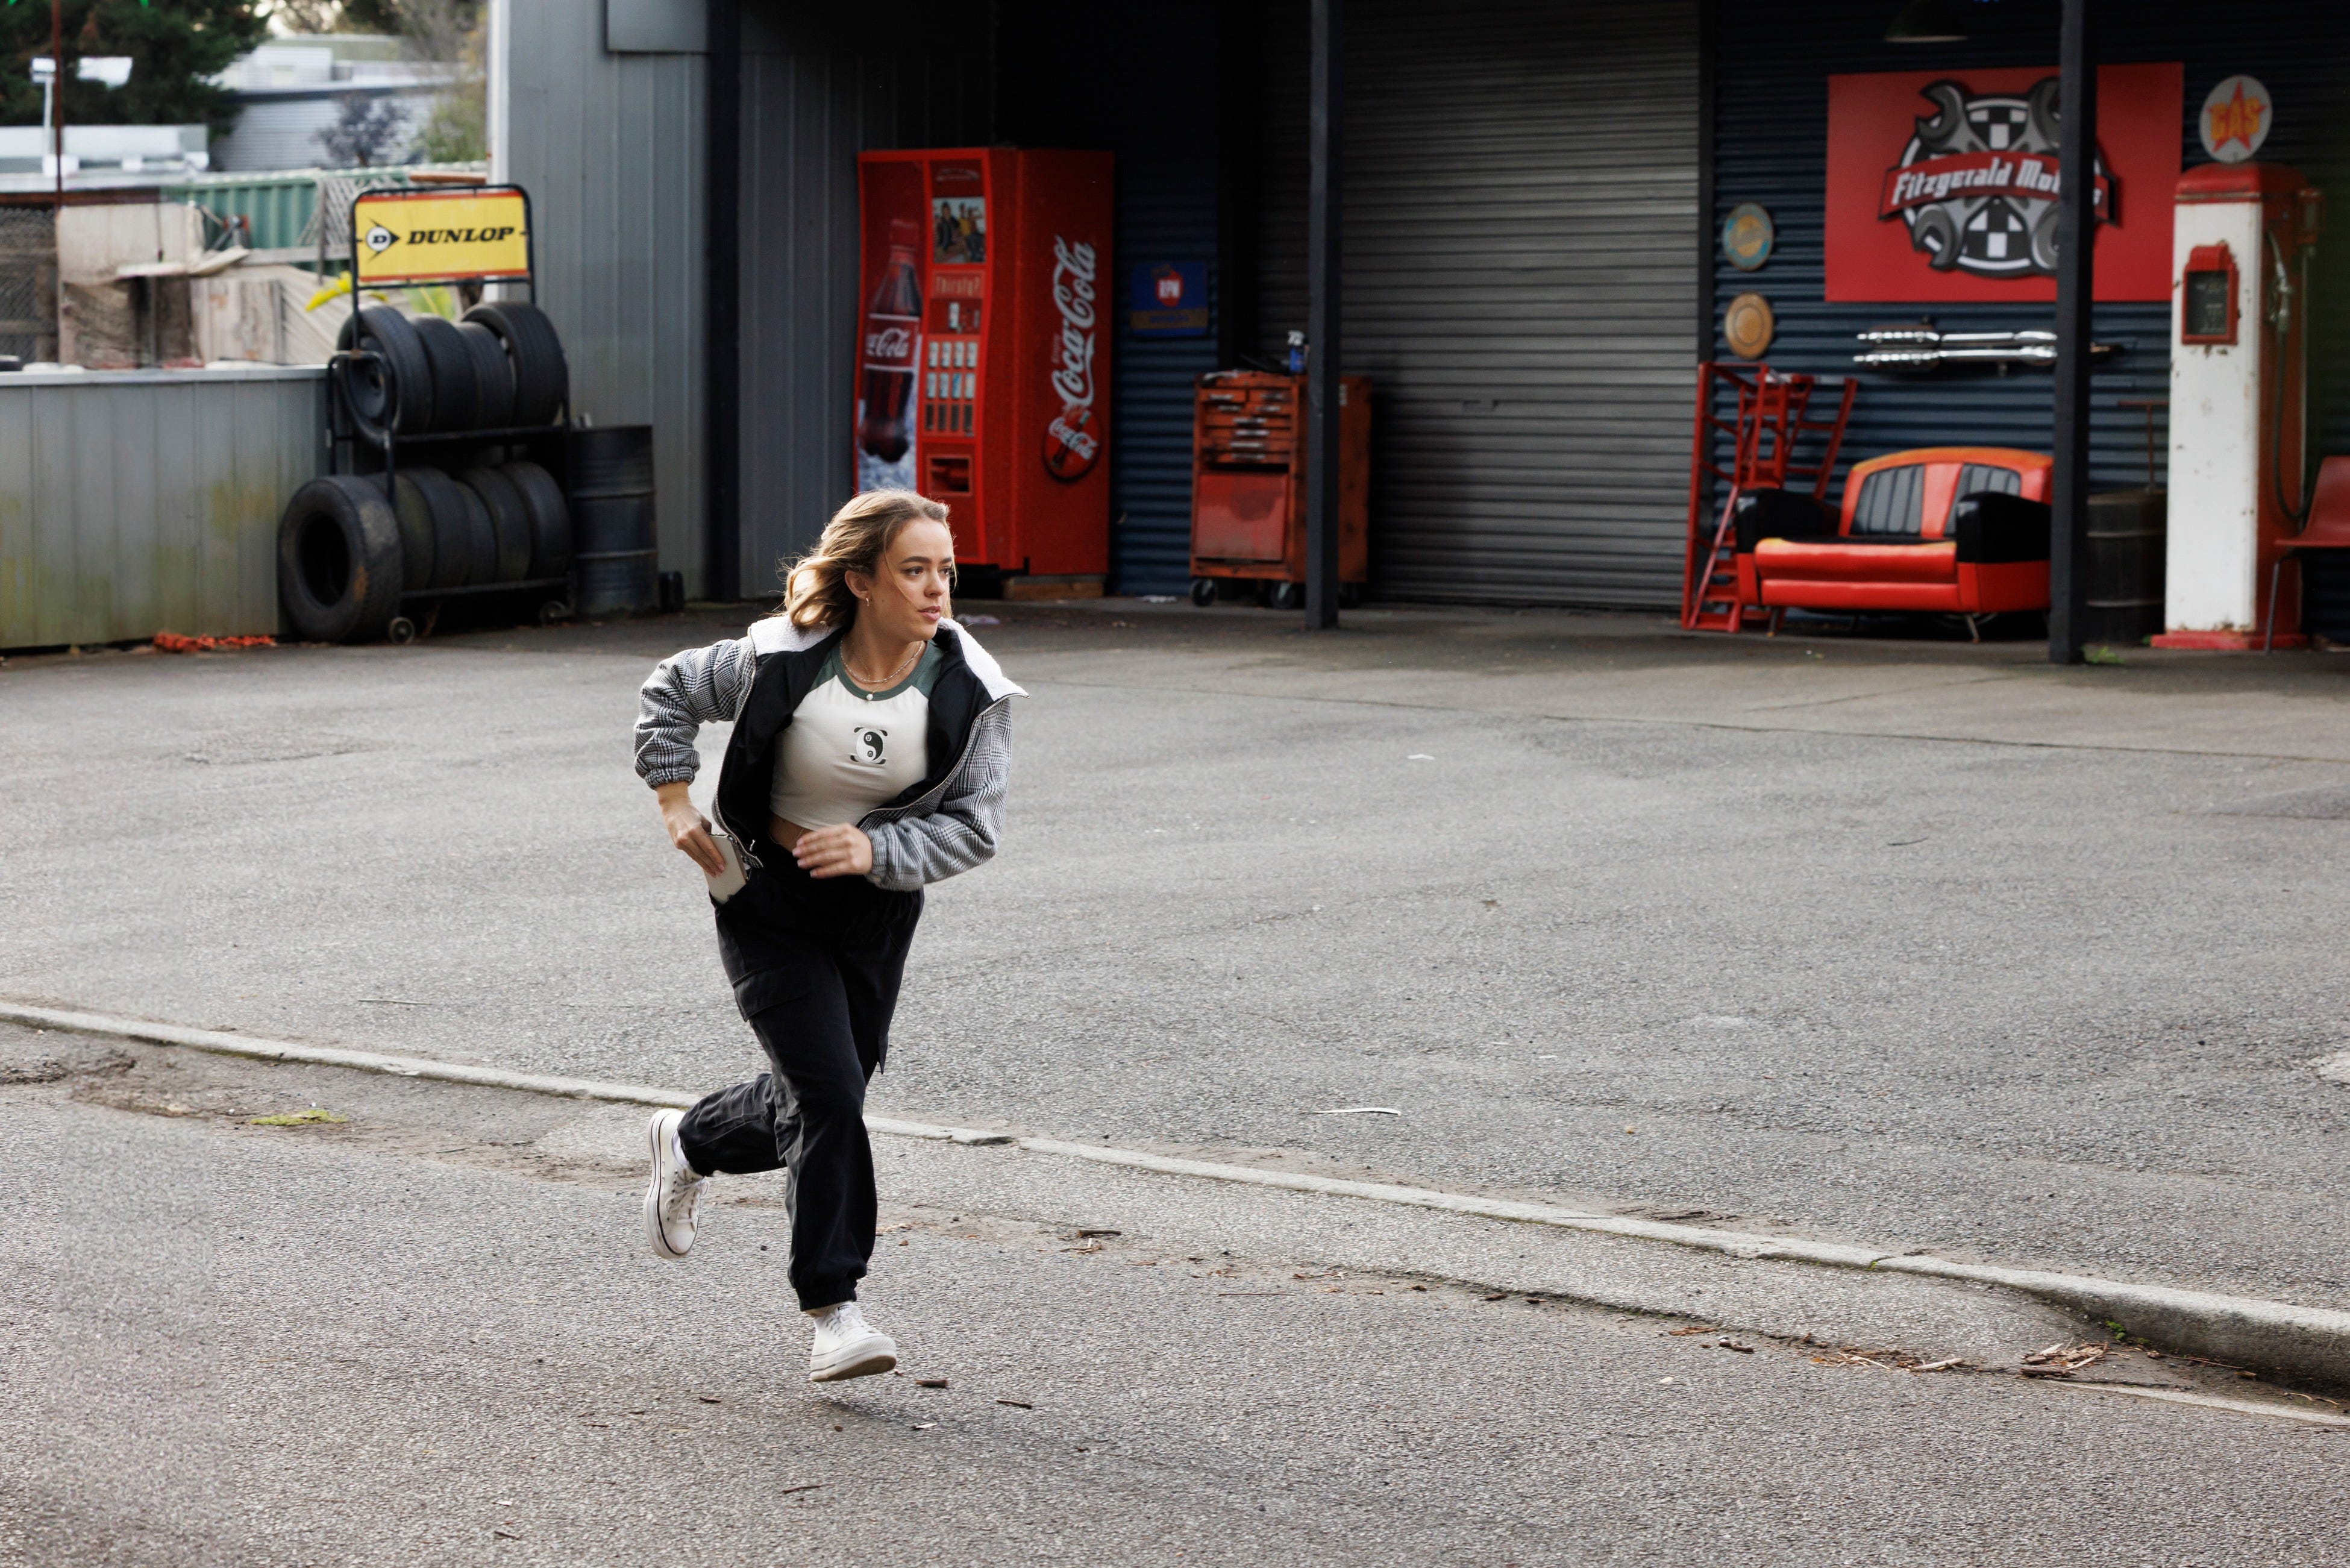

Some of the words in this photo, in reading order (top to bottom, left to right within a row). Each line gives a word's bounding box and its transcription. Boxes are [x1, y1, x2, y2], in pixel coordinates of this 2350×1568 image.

[2210, 96, 2260, 140] GAS
[1891, 157, 2013, 206] Fitzgerald
[2015, 158, 2102, 206] Mots
[407, 226, 515, 245] DUNLOP
[1051, 233, 1097, 409] Coca-Cola
